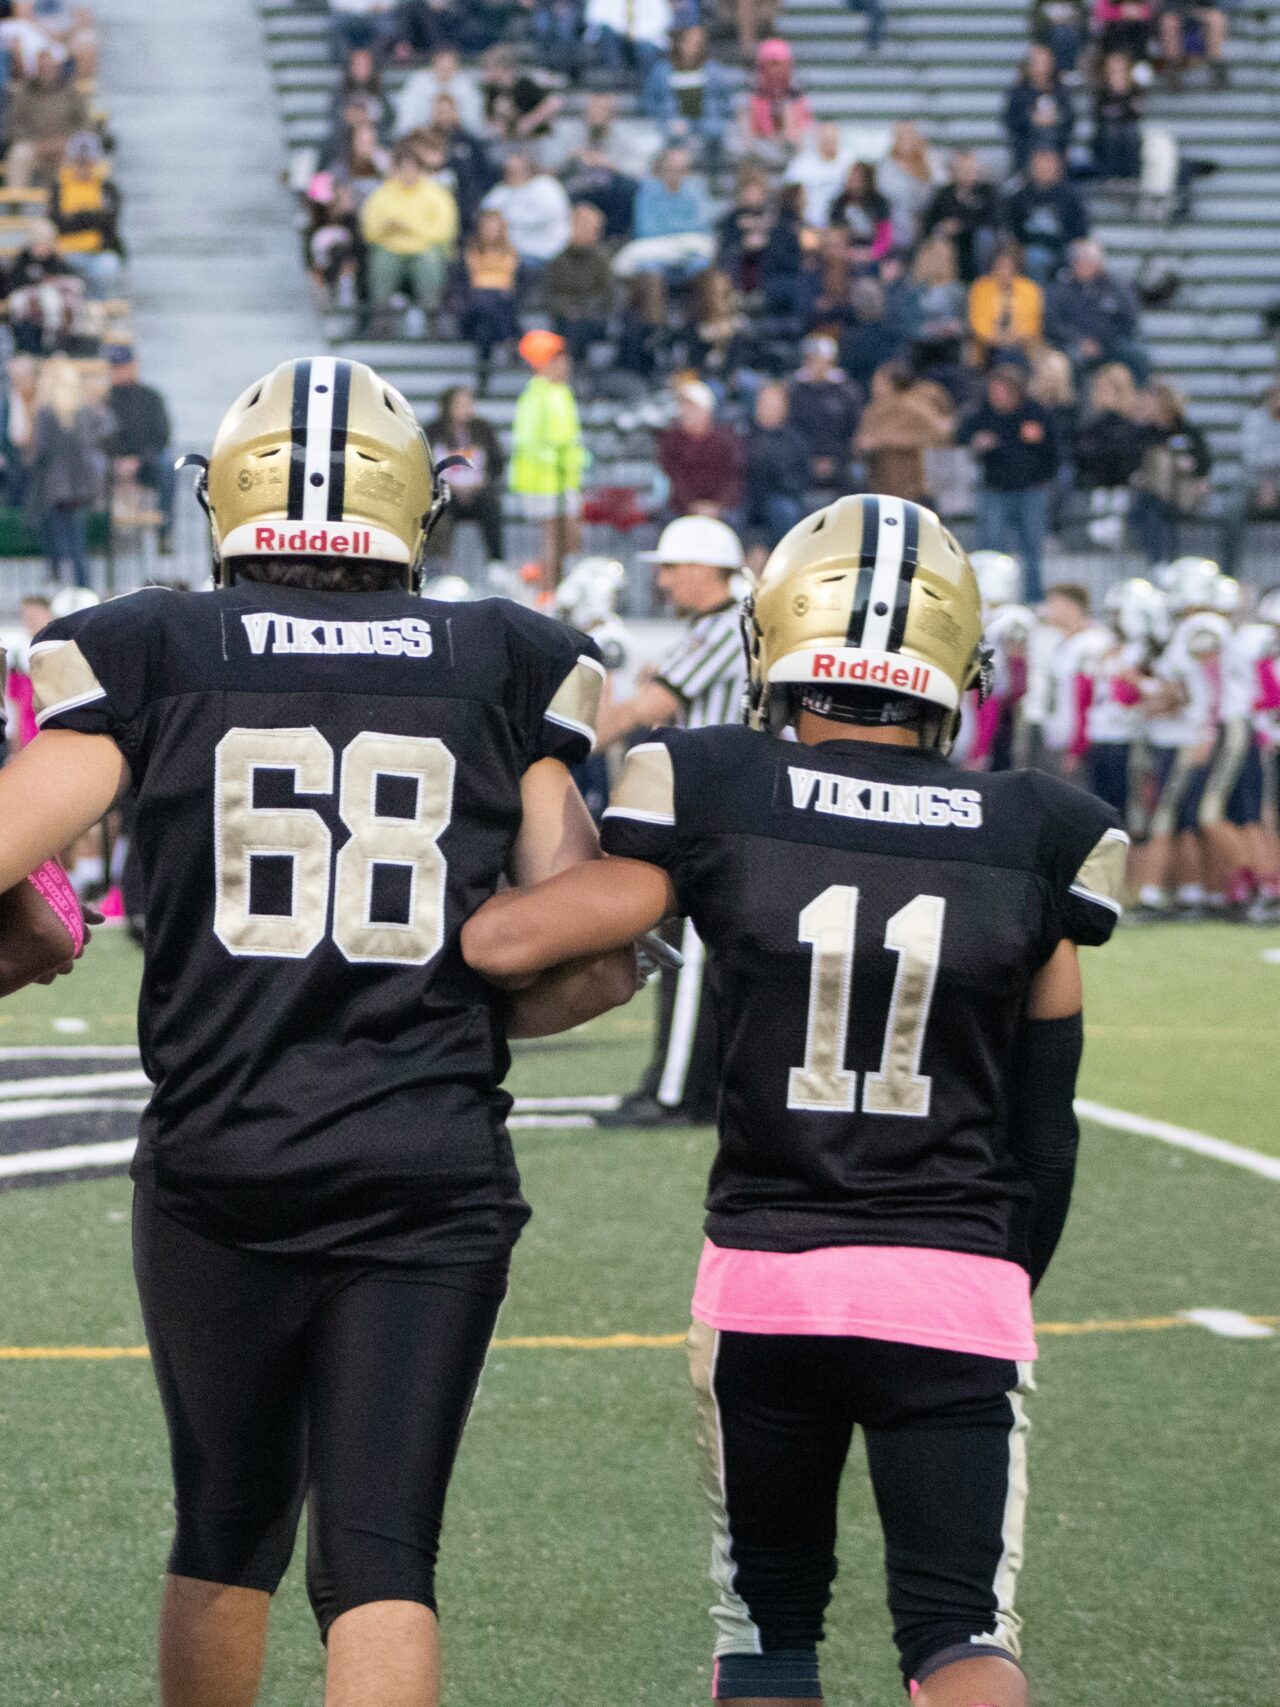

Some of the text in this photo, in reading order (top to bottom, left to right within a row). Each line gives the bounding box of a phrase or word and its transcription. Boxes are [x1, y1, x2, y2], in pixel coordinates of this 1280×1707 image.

[256, 528, 370, 554] Riddell
[241, 612, 433, 658] VIKINGS
[811, 654, 930, 693] Riddell
[787, 766, 983, 828] VIKINGS
[214, 725, 457, 965] 68
[787, 885, 946, 1116] 11
